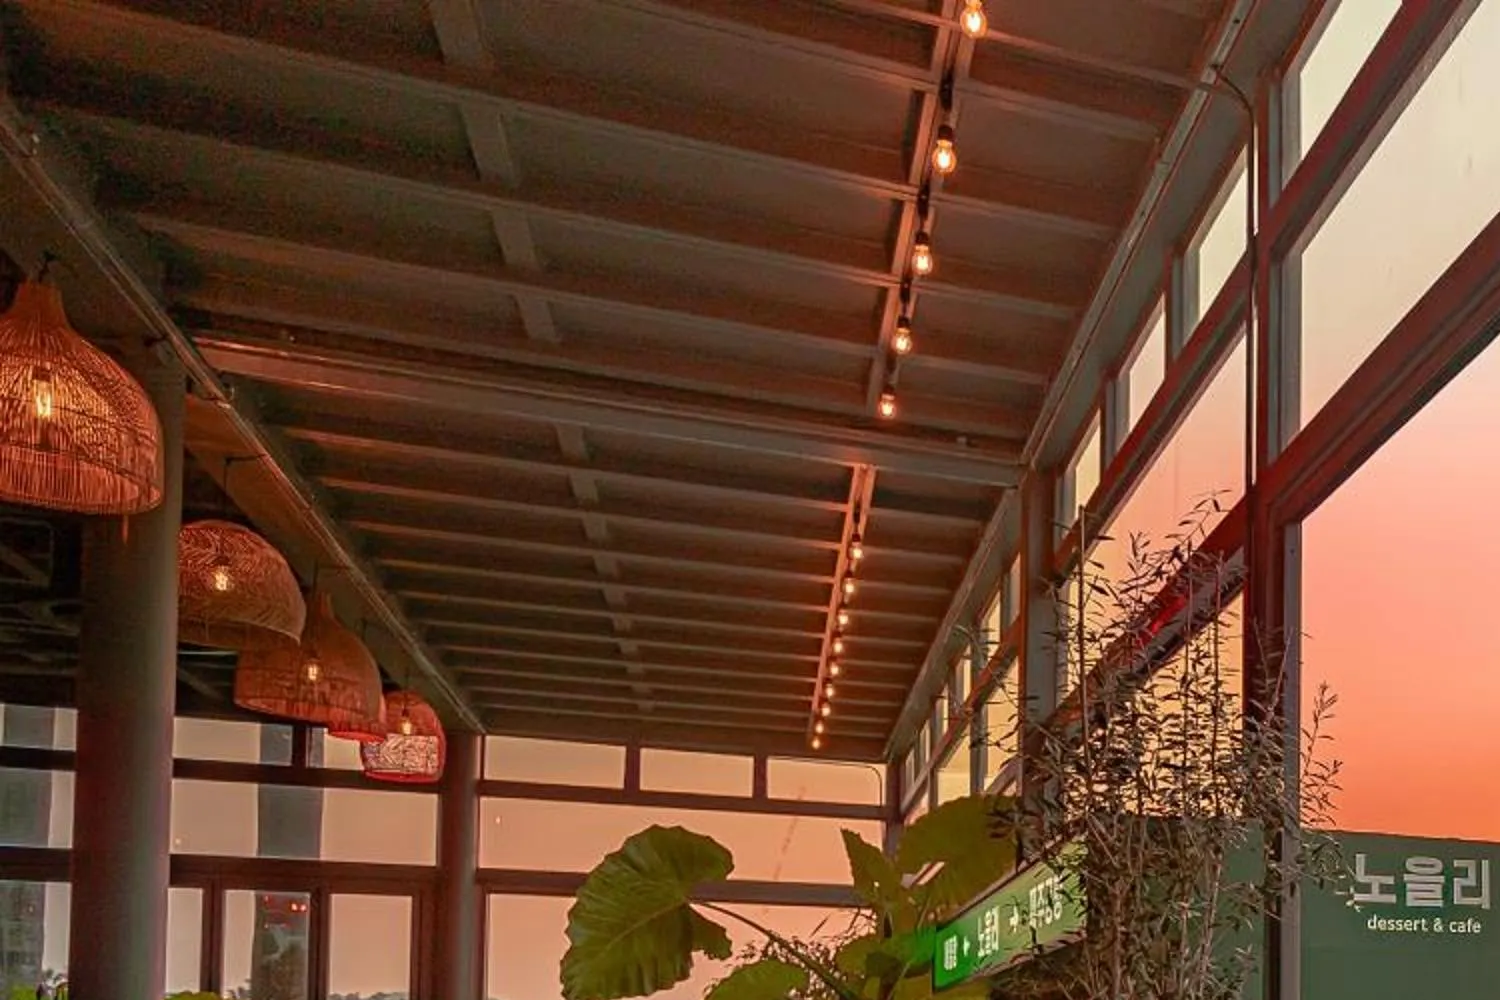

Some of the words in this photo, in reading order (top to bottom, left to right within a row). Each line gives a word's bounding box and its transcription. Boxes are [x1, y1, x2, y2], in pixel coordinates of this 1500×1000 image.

[1353, 853, 1490, 909] 노을리
[1367, 914, 1428, 932] dessert
[1433, 917, 1444, 932] &
[1449, 918, 1482, 933] cafe
